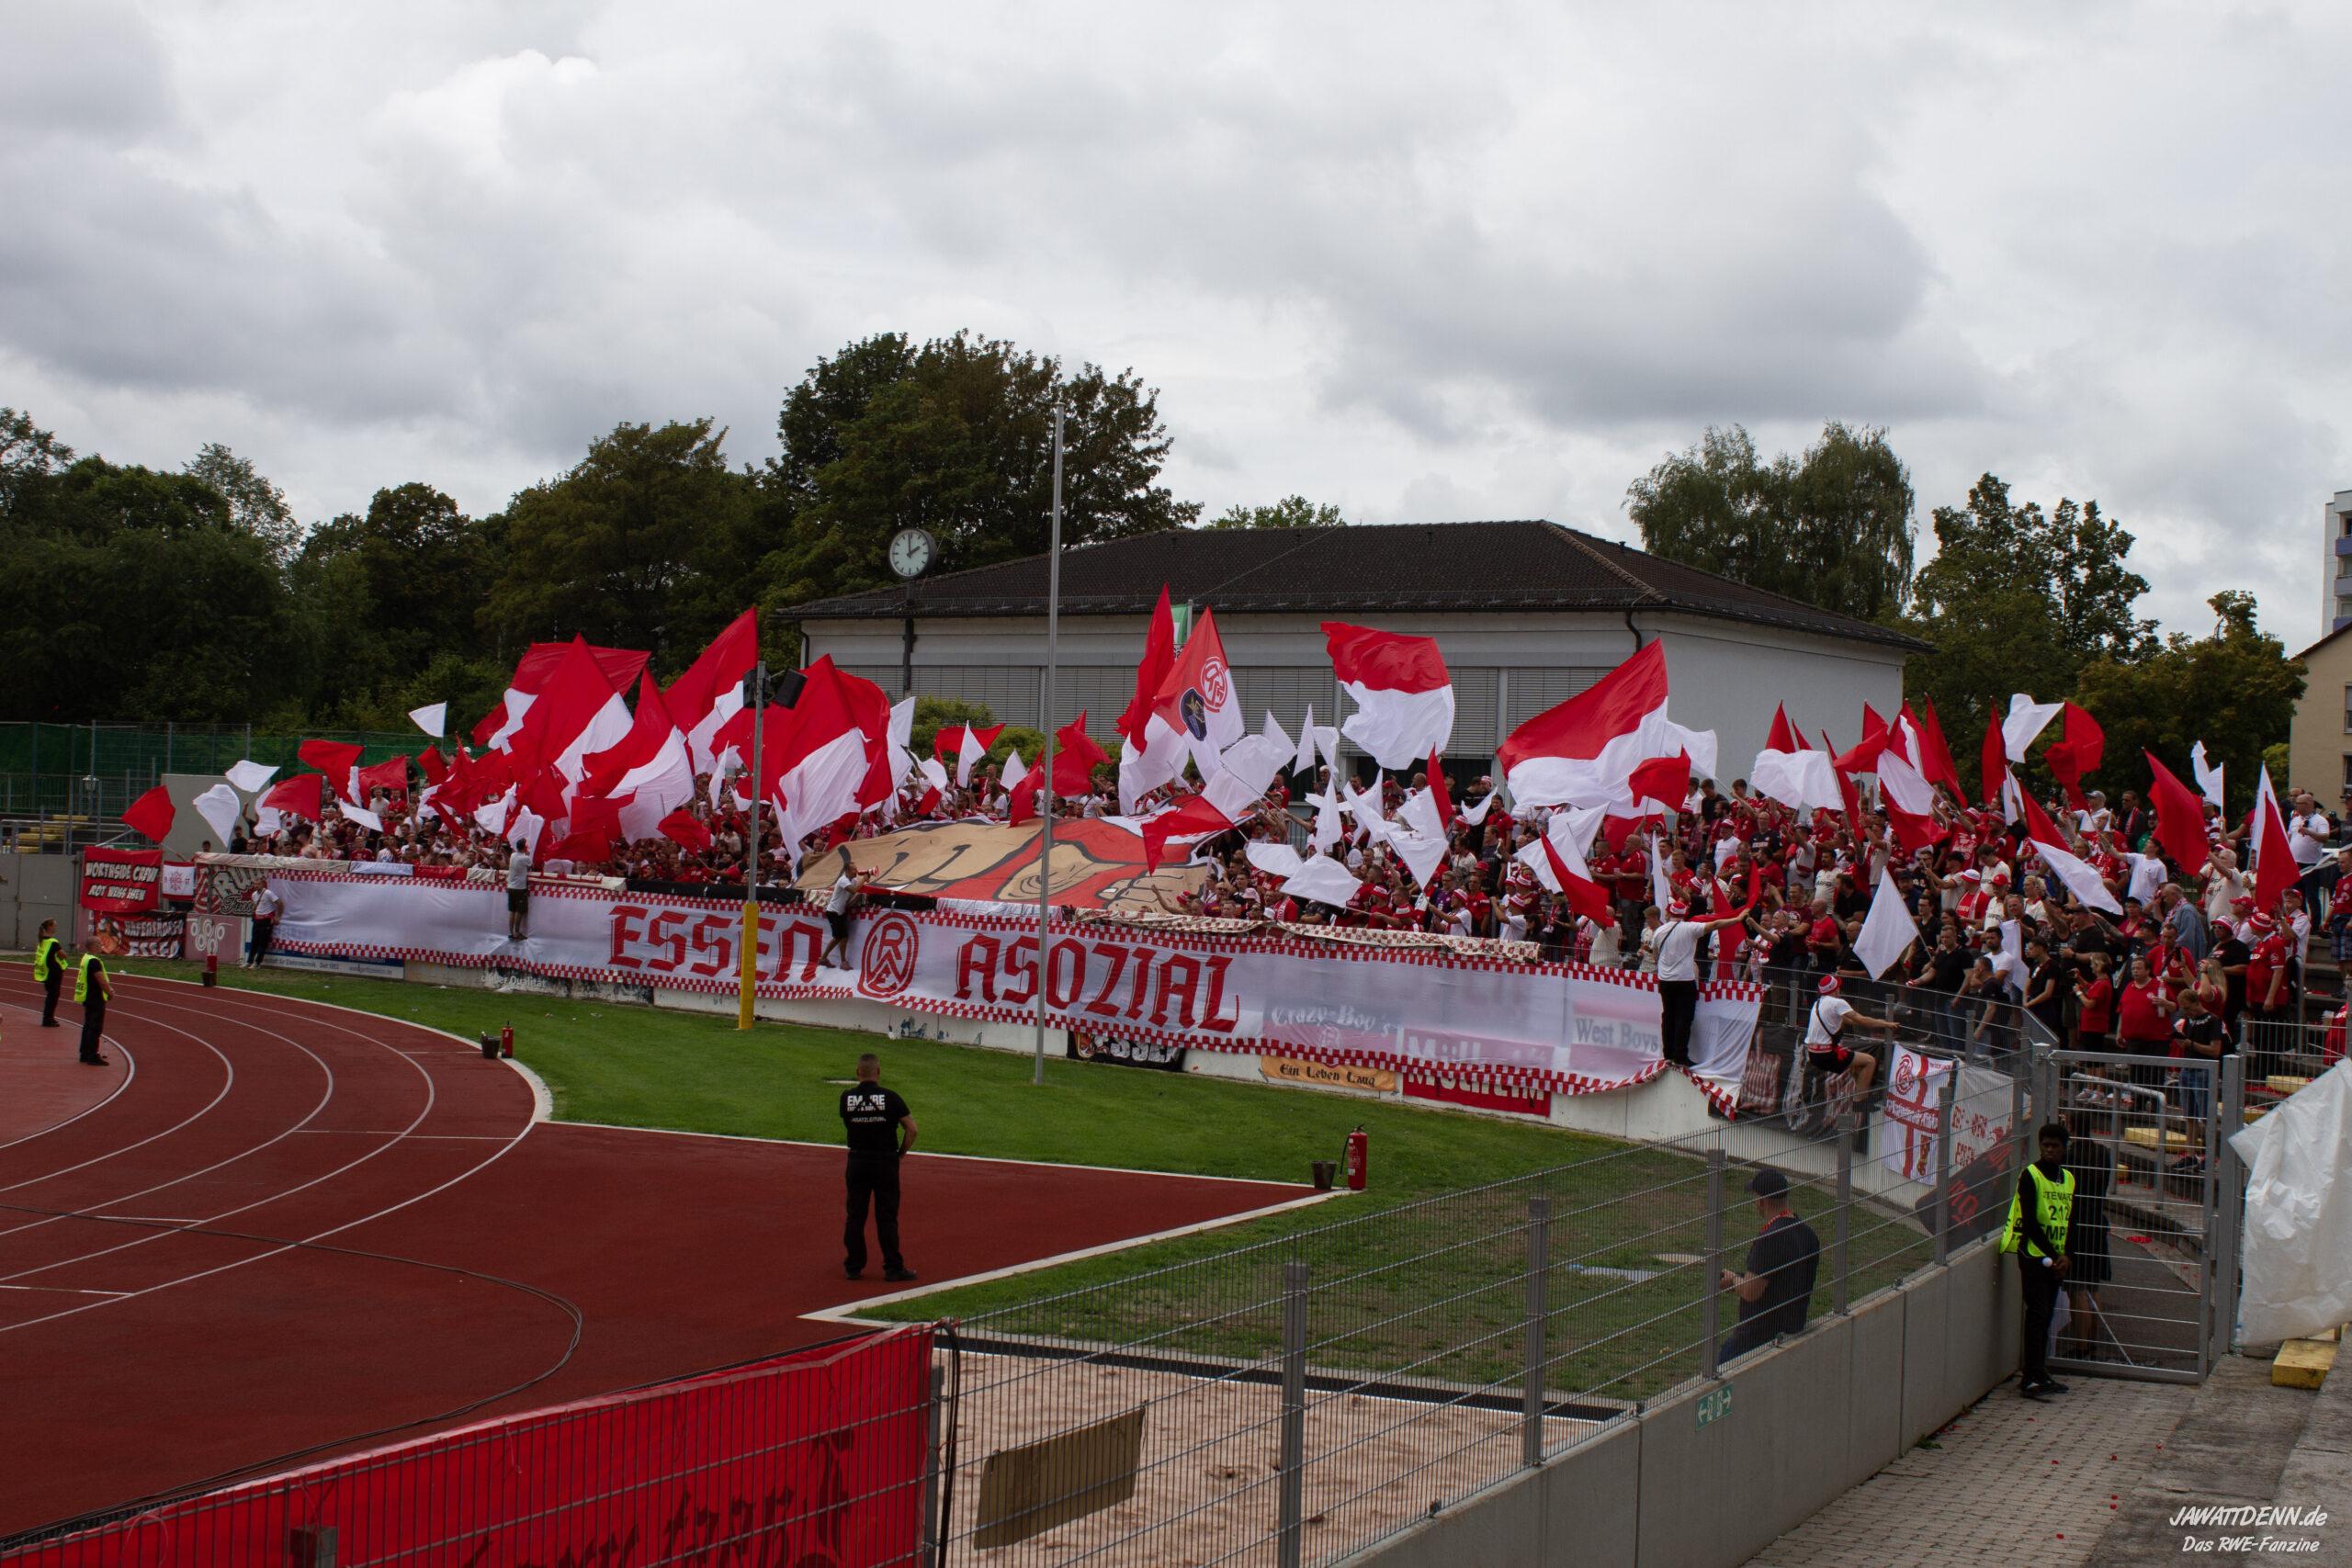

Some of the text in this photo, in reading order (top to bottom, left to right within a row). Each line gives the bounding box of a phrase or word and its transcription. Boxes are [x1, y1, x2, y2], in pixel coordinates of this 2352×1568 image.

[85, 862, 131, 880] NORTHSIDE
[608, 905, 824, 983] ESSEN
[953, 933, 1240, 1033] ASOZIAL
[1575, 1017, 1658, 1055] West Boys
[1279, 1063, 1299, 1077] Ein
[1306, 1066, 1340, 1081] Leben
[2048, 1205, 2071, 1221] 212
